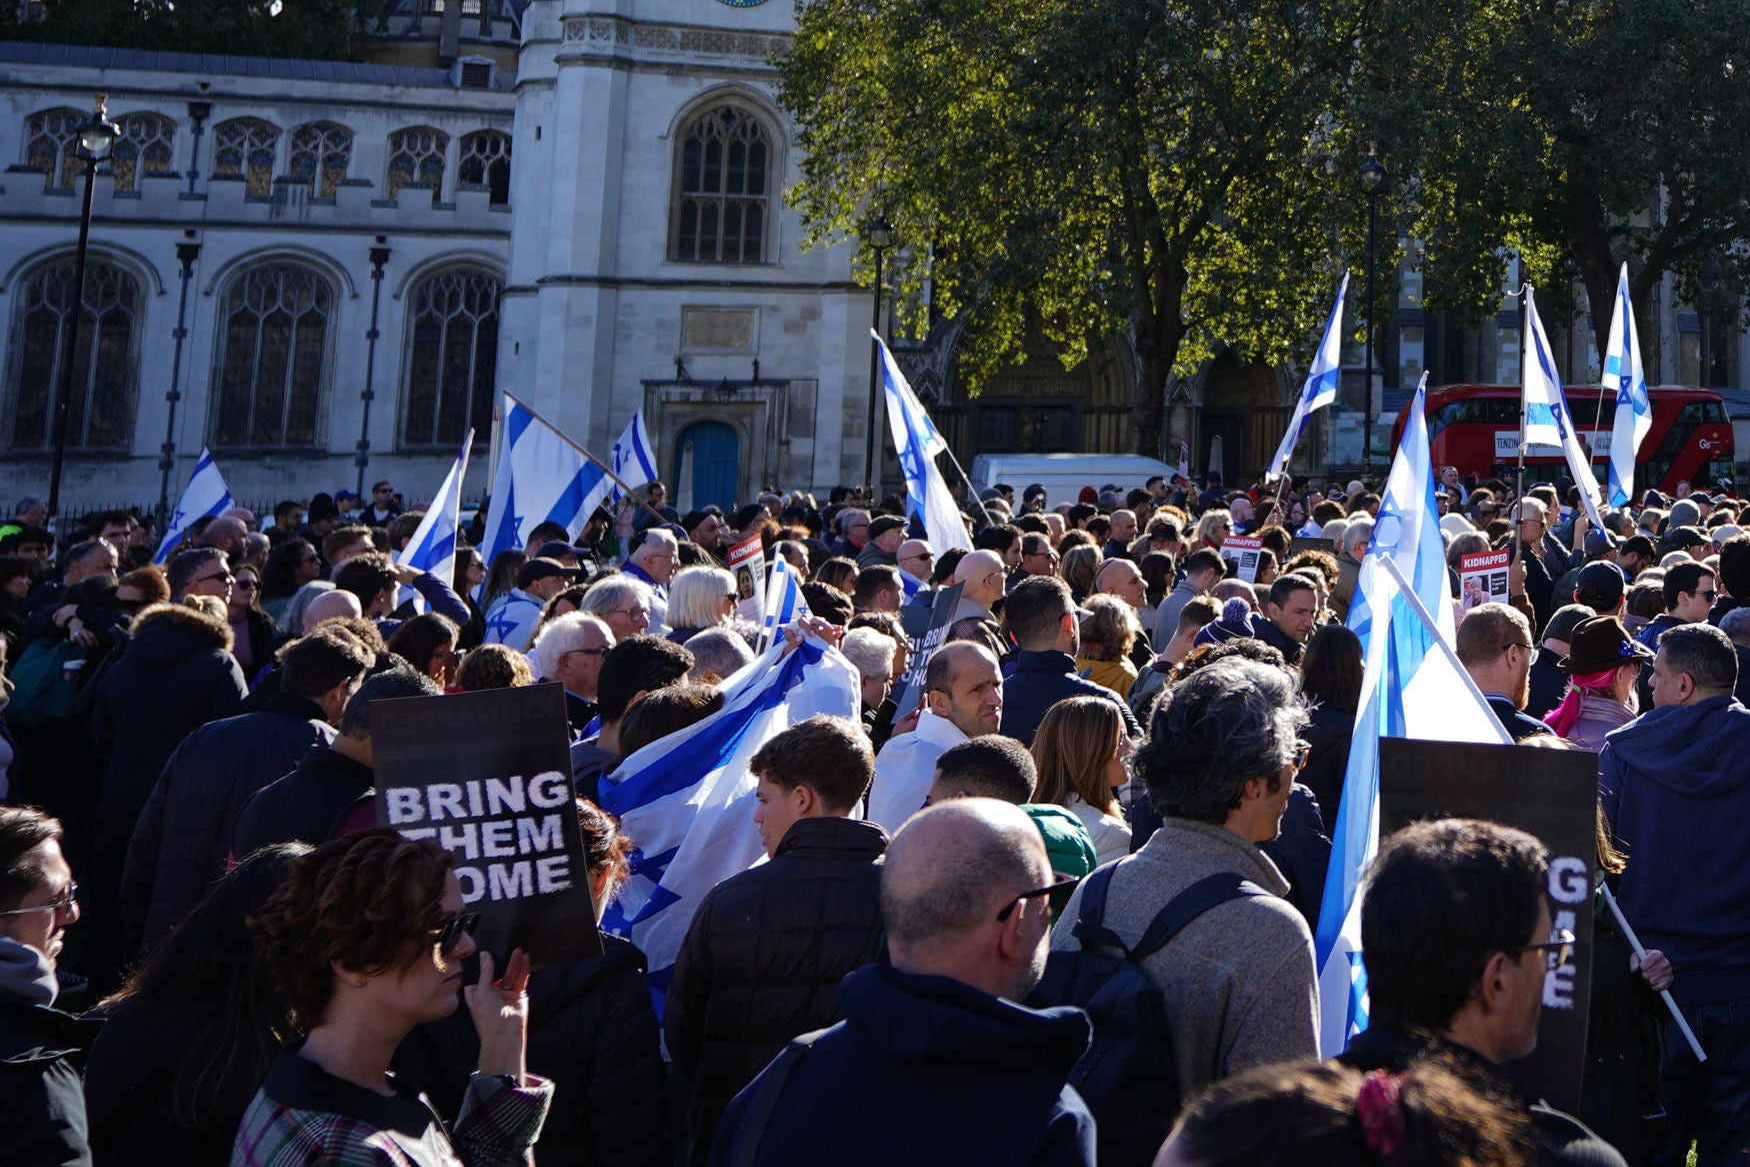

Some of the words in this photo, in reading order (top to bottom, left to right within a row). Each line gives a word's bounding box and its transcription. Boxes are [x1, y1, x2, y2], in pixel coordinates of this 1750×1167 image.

[1224, 538, 1260, 547] KIDNAPPED
[1464, 554, 1507, 568] KIDNAPPED
[385, 770, 570, 825] BRING
[454, 854, 572, 904] OME
